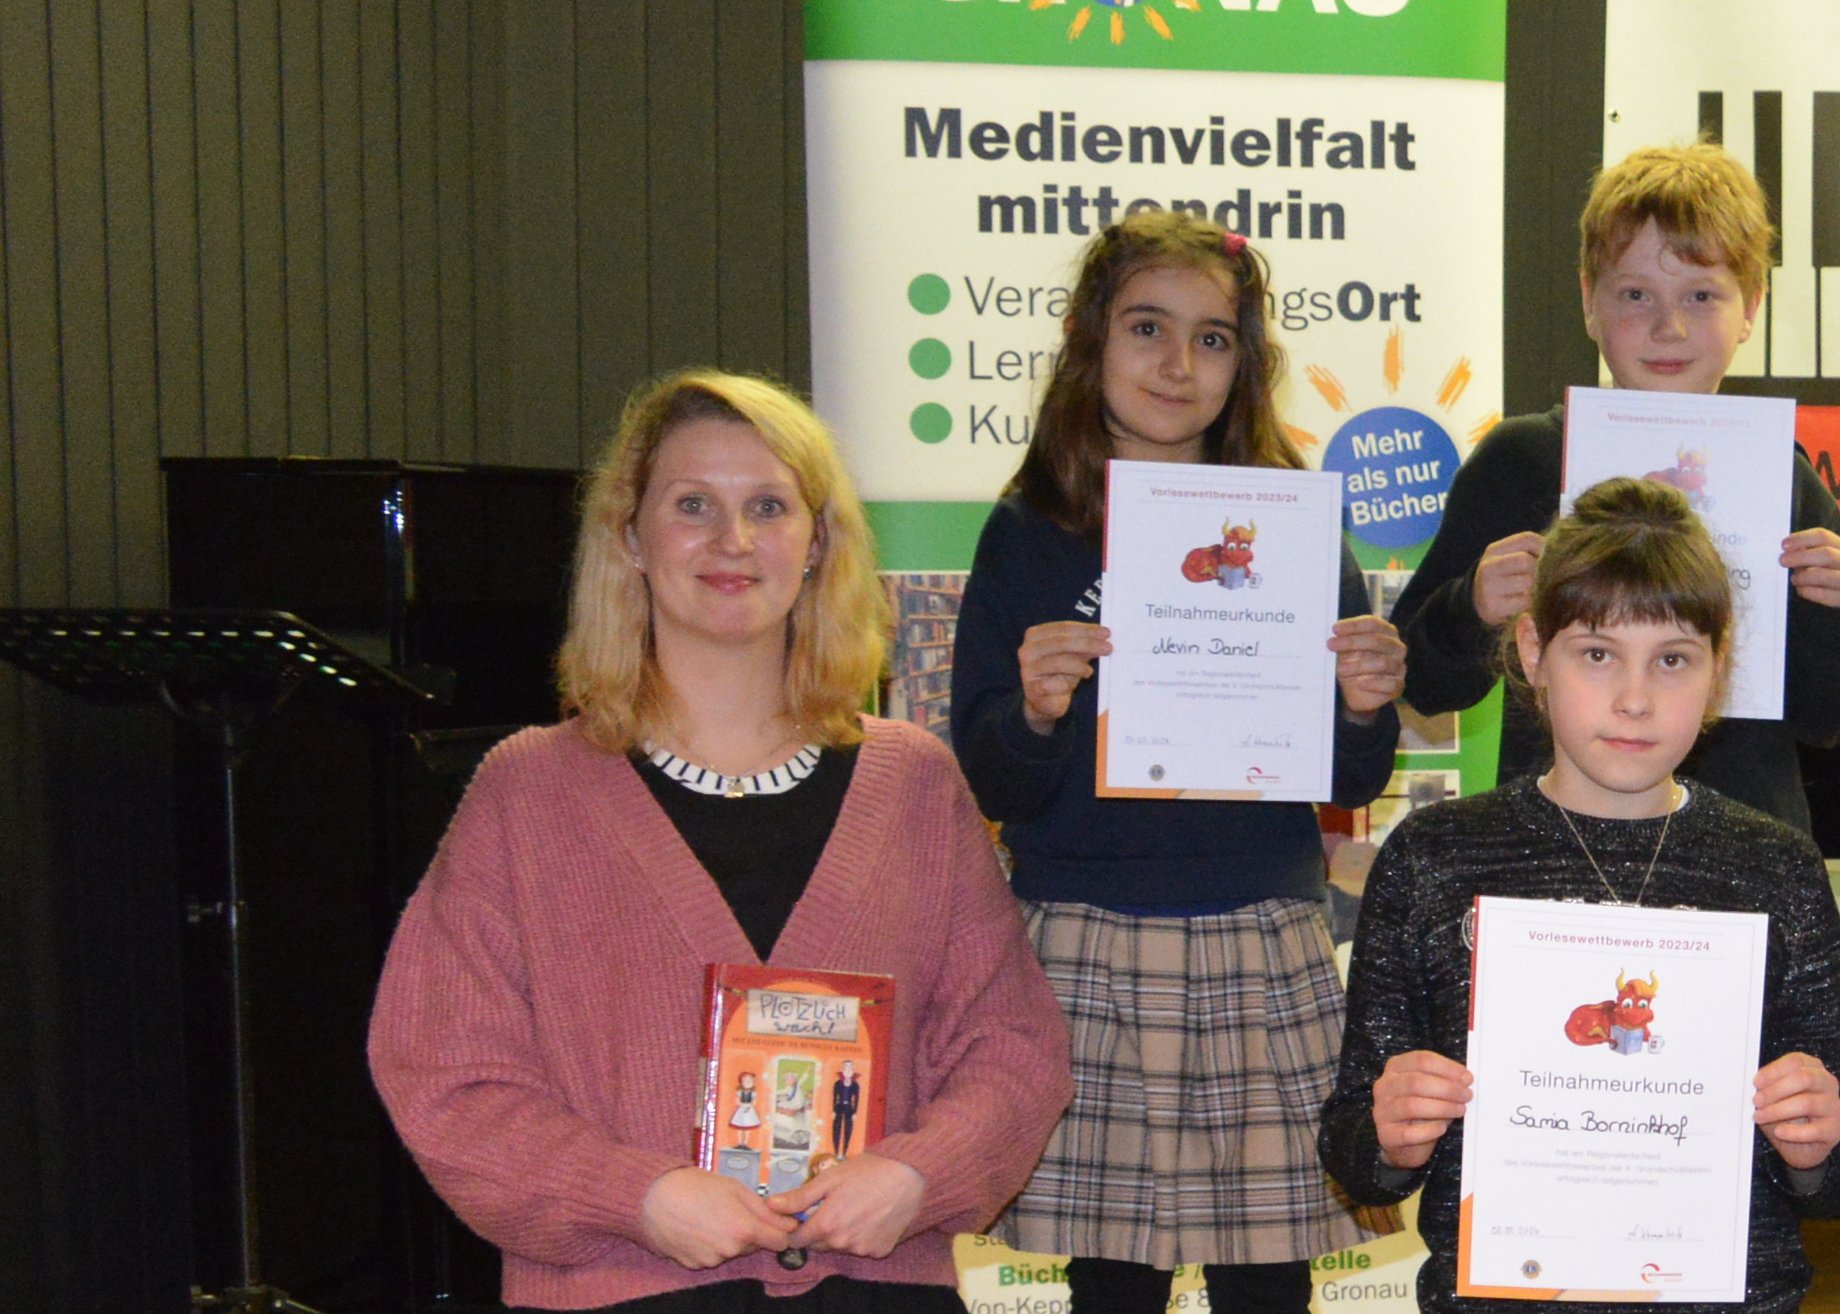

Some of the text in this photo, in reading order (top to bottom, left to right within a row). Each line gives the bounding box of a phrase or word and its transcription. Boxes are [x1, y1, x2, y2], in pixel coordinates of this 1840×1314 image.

[902, 106, 1417, 172] Medienvielfalt
[1351, 429, 1425, 462] Mehr
[1347, 457, 1441, 494] als nur
[1149, 486, 1253, 501] Vorlesewettbewerb
[1350, 489, 1448, 527] Bücher
[1144, 603, 1297, 624] Teilnahmeurkunde
[1152, 637, 1259, 657] Nevin Daniel
[1528, 929, 1711, 953] Vorlesewettbewerb 2023/24
[1519, 1068, 1705, 1097] Teilnahmeurkunde
[1509, 1104, 1571, 1132] Samia
[1321, 1280, 1409, 1302] Gronau
